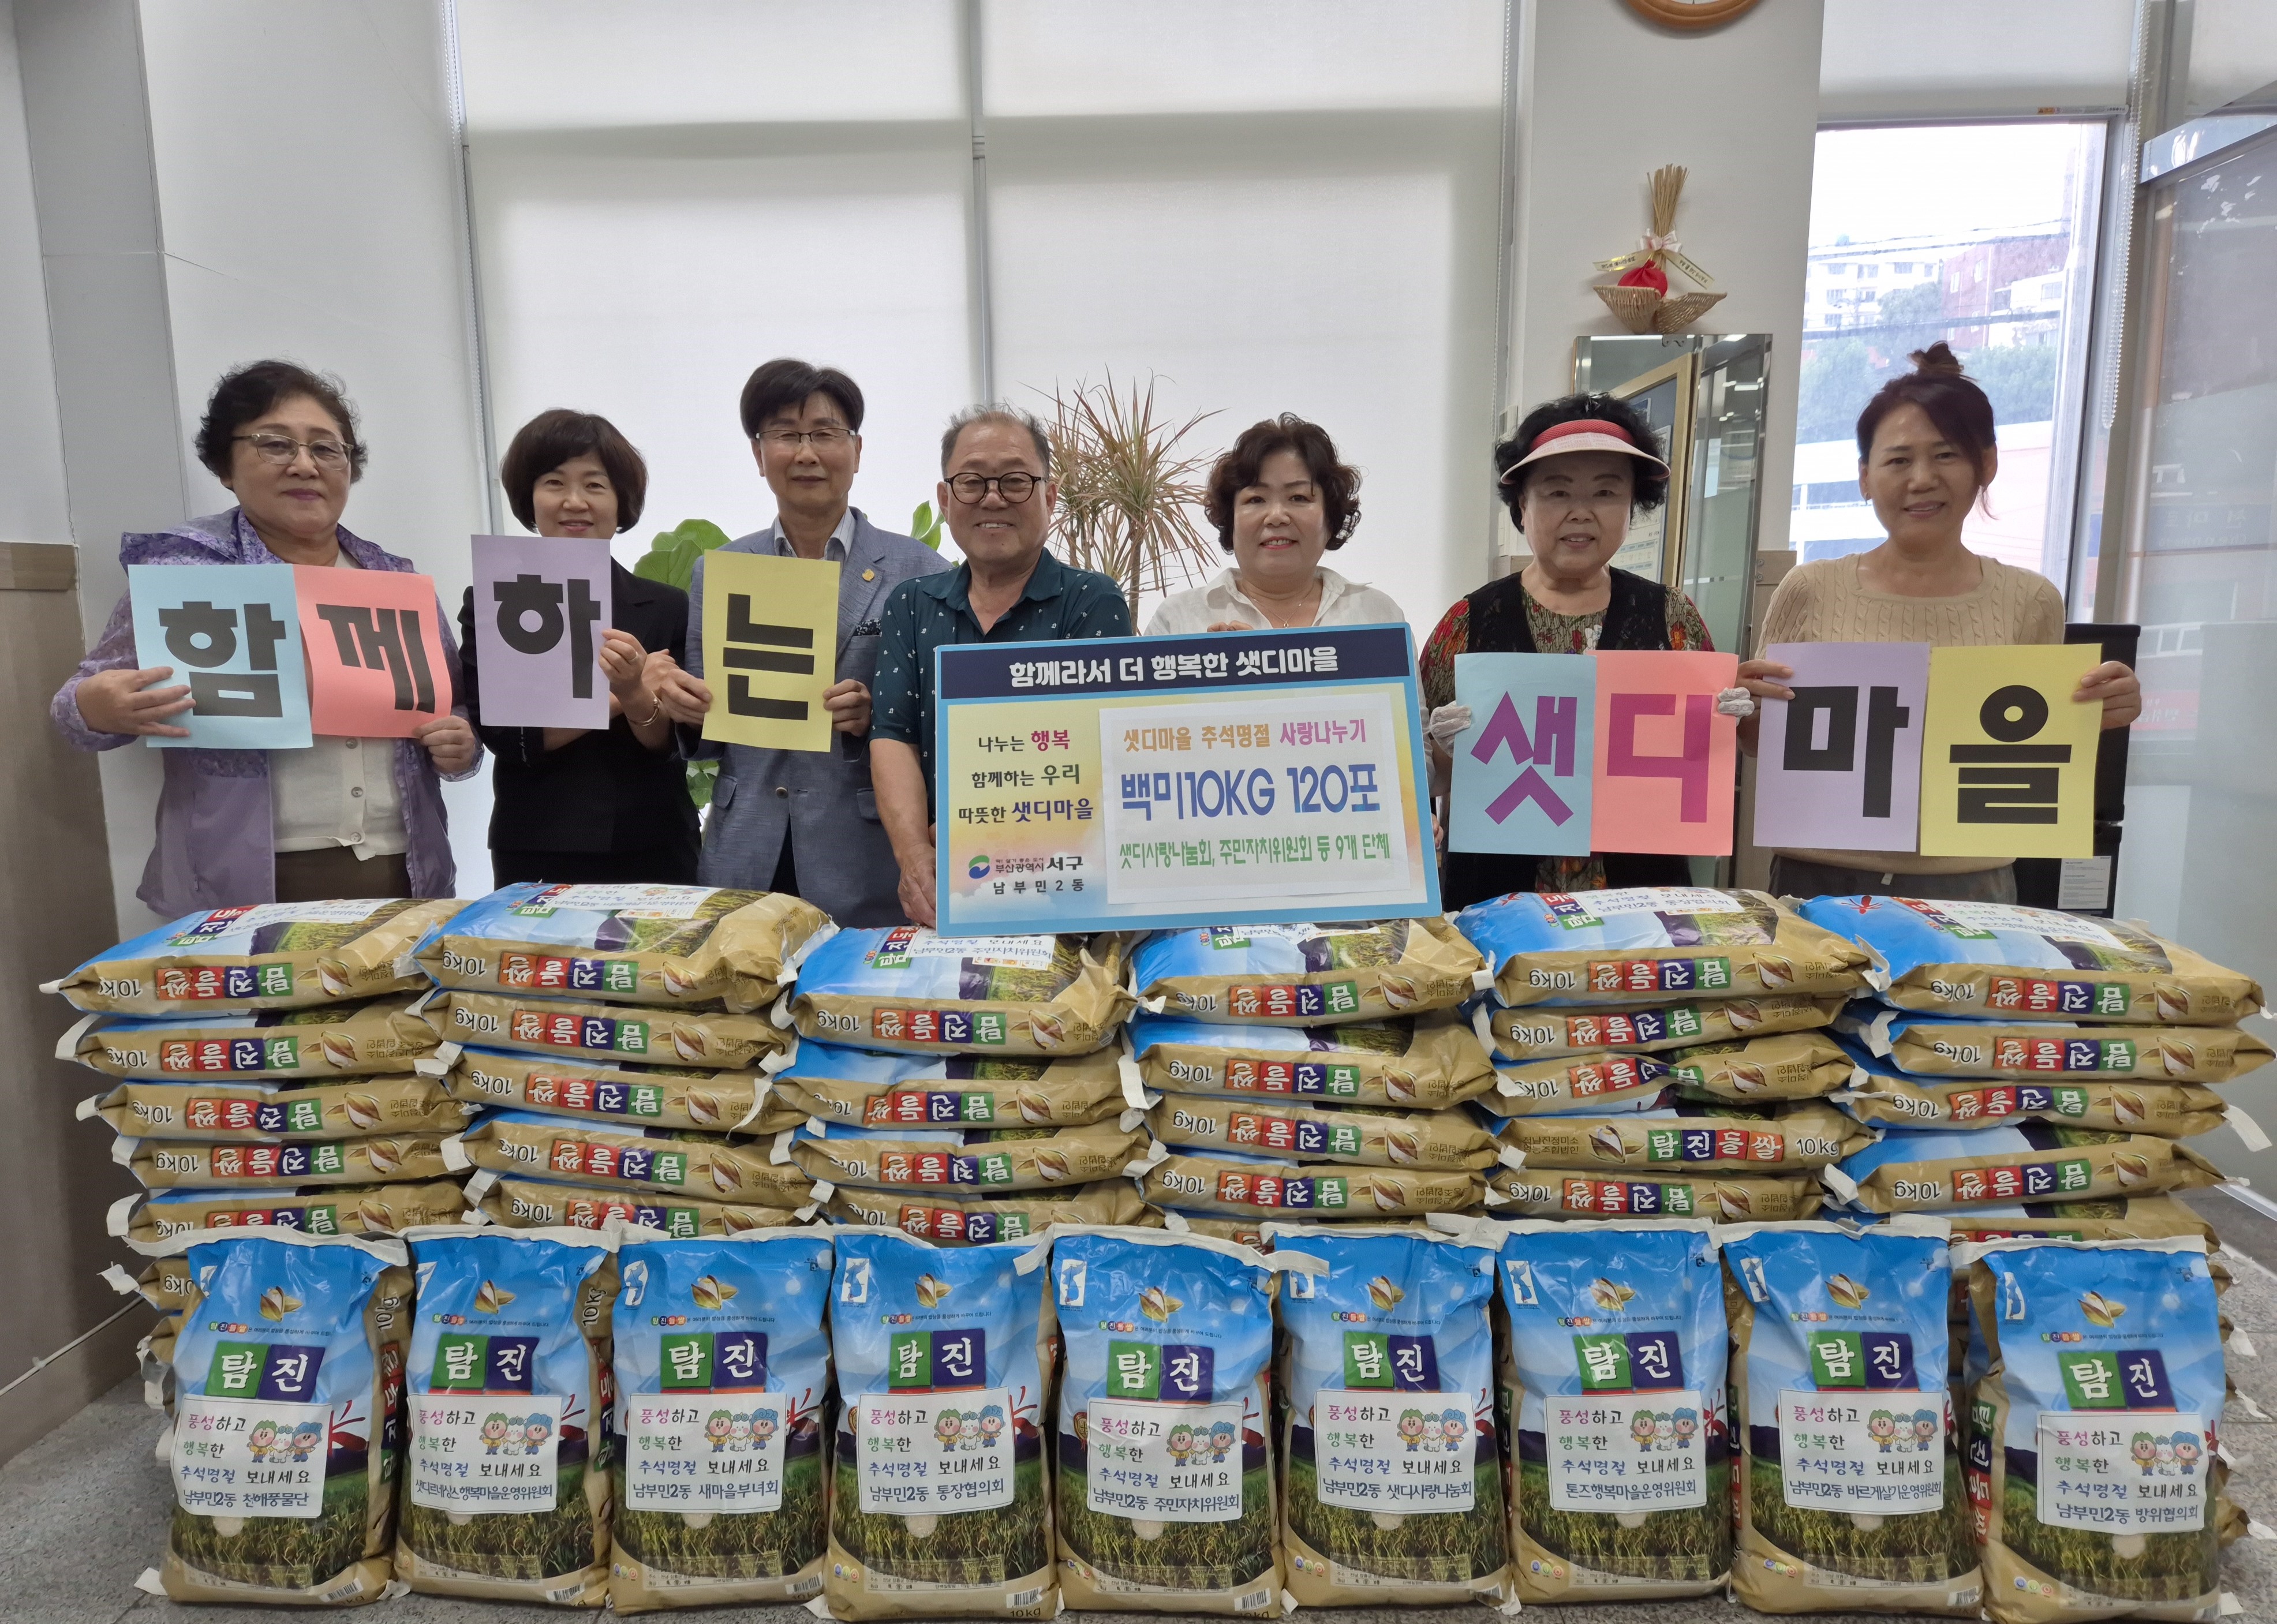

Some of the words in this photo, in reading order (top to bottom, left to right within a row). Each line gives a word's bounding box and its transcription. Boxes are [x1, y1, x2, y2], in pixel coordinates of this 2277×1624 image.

[1009, 658, 1111, 687] 함께라서
[1120, 657, 1144, 680] 더
[1150, 653, 1228, 679] 행복한
[1236, 646, 1338, 676] 샛디마을
[978, 735, 1025, 753] 나누는
[1031, 729, 1071, 751] 행복
[1124, 726, 1190, 753] 샛디마을
[1202, 724, 1270, 750] 추석명절
[1280, 719, 1367, 744] 사랑나누기
[971, 769, 1034, 789] 함께하는
[1041, 764, 1080, 785] 우리
[1121, 769, 1275, 821] 백미10KG
[1287, 764, 1380, 814] 120포
[958, 806, 1005, 824] 따뜻한
[1011, 798, 1094, 822] 샛디마을
[1120, 838, 1215, 870] 샛디사랑나눔회,
[1220, 835, 1312, 866] 주민자치위원회
[1317, 835, 1329, 862] 등
[1336, 836, 1357, 860] 9개
[1363, 833, 1390, 859] 단체
[996, 863, 1044, 873] 부산광역시
[1046, 856, 1083, 870] 서구
[993, 879, 1084, 895] 남부민2동
[443, 951, 487, 975] 10kg
[1530, 970, 1575, 988] 10kg
[1931, 981, 1976, 1000] 10kg
[456, 1008, 499, 1032] 10kg
[817, 1011, 860, 1031] 10kg
[1511, 1024, 1554, 1045] 10kg
[1170, 1061, 1213, 1083] 10kg
[1893, 1094, 1938, 1117] 10kg
[1174, 1111, 1217, 1135] 10kg
[1524, 1136, 1579, 1145] 전남진정미소
[1796, 1137, 1839, 1156] 10kg
[157, 1152, 199, 1172] 10kg
[1162, 1171, 1206, 1195] 10kg
[1510, 1182, 1552, 1202] 10kg
[1895, 1179, 1942, 1200] 10kg
[512, 1199, 553, 1222] 10kg
[188, 1413, 246, 1433] 풍성하고
[419, 1409, 476, 1426] 풍성하고
[640, 1408, 700, 1425] 풍성하고
[870, 1409, 928, 1425] 풍성하고
[1329, 1405, 1391, 1422] 풍성하고
[1559, 1409, 1624, 1425] 풍성하고
[1793, 1406, 1860, 1423] 풍성하고
[1101, 1418, 1161, 1436] 풍성하고
[417, 1435, 457, 1453] 행복한
[638, 1435, 682, 1451] 행복한
[868, 1436, 911, 1453] 행복한
[1326, 1432, 1374, 1450] 행복한
[1559, 1435, 1608, 1450] 행복한
[1794, 1434, 1845, 1450] 행복한
[2057, 1430, 2123, 1446] 풍성하고
[184, 1440, 225, 1459] 행복한
[1099, 1445, 1143, 1463] 행복한
[420, 1459, 469, 1478] 추석명절
[478, 1462, 542, 1478] 보내세요
[638, 1460, 697, 1476] 추석명절
[708, 1459, 769, 1475] 보내세요
[869, 1462, 928, 1477] 추석명절
[938, 1457, 1001, 1476] 보내세요
[1329, 1457, 1390, 1475] 추석명절
[1402, 1459, 1463, 1474] 보내세요
[1561, 1459, 1626, 1475] 추석명절
[1637, 1457, 1695, 1474] 보내세요
[1796, 1458, 1865, 1476] 추석명절
[1876, 1460, 1934, 1475] 보내세요
[2055, 1457, 2108, 1473] 행복한
[180, 1466, 235, 1484] 추석명절
[245, 1469, 312, 1485] 보내세요
[1099, 1468, 1159, 1488] 추석명절
[1168, 1472, 1231, 1488] 보내세요
[633, 1483, 692, 1499] 남부민2동
[698, 1480, 779, 1499] 새마을부녀회
[870, 1485, 929, 1502] 남부민2동
[937, 1478, 1004, 1499] 통장협의회
[1323, 1479, 1379, 1498] 남부민2동
[1387, 1480, 1471, 1499] 샛디사랑나눔회
[1566, 1479, 1696, 1499] 톤즈행복마을운영위원회
[1789, 1480, 1842, 1498] 남부민2동
[2057, 1481, 2127, 1499] 추석명절
[2138, 1482, 2198, 1499] 보내세요
[184, 1492, 236, 1508] 남부민2동
[1093, 1488, 1148, 1509] 남부민2동
[1154, 1494, 1239, 1513] 주민자치위원회
[2056, 1503, 2128, 1523] 남부민2동
[2136, 1505, 2198, 1522] 방위협의회
